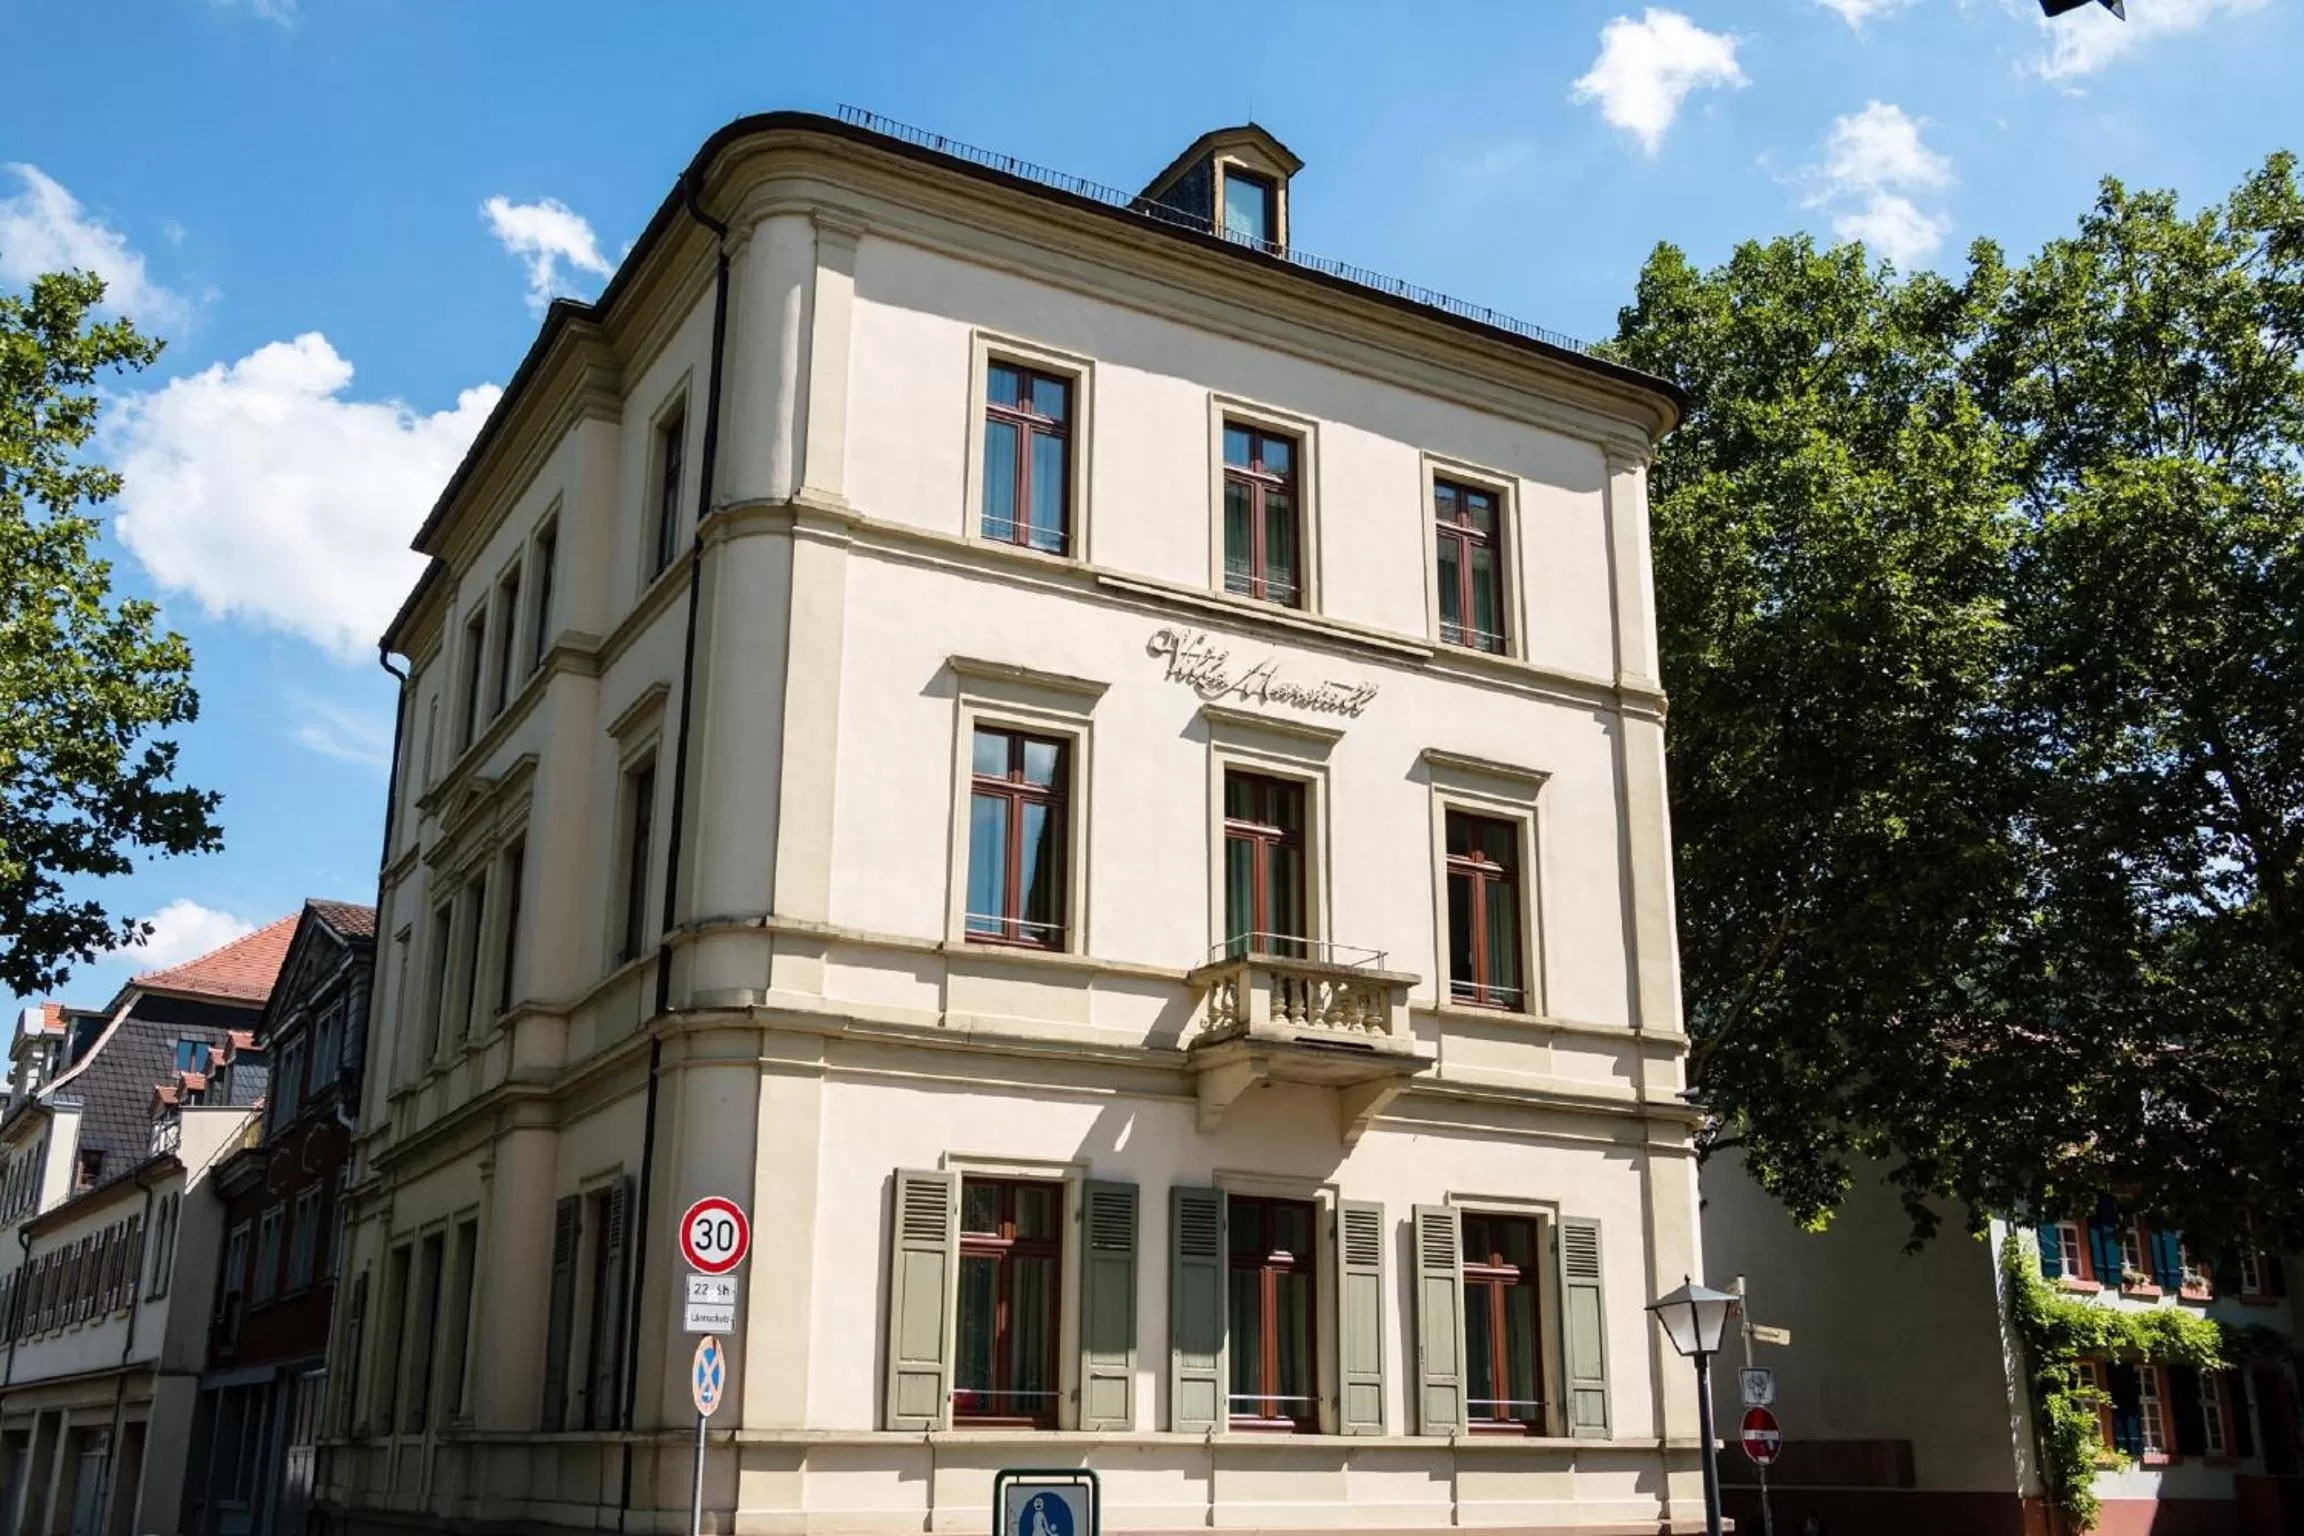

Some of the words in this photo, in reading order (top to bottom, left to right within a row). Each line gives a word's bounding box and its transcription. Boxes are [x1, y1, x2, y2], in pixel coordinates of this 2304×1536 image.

[1146, 629, 1229, 687] Villa
[695, 1219, 734, 1251] 30
[694, 1283, 709, 1296] 22
